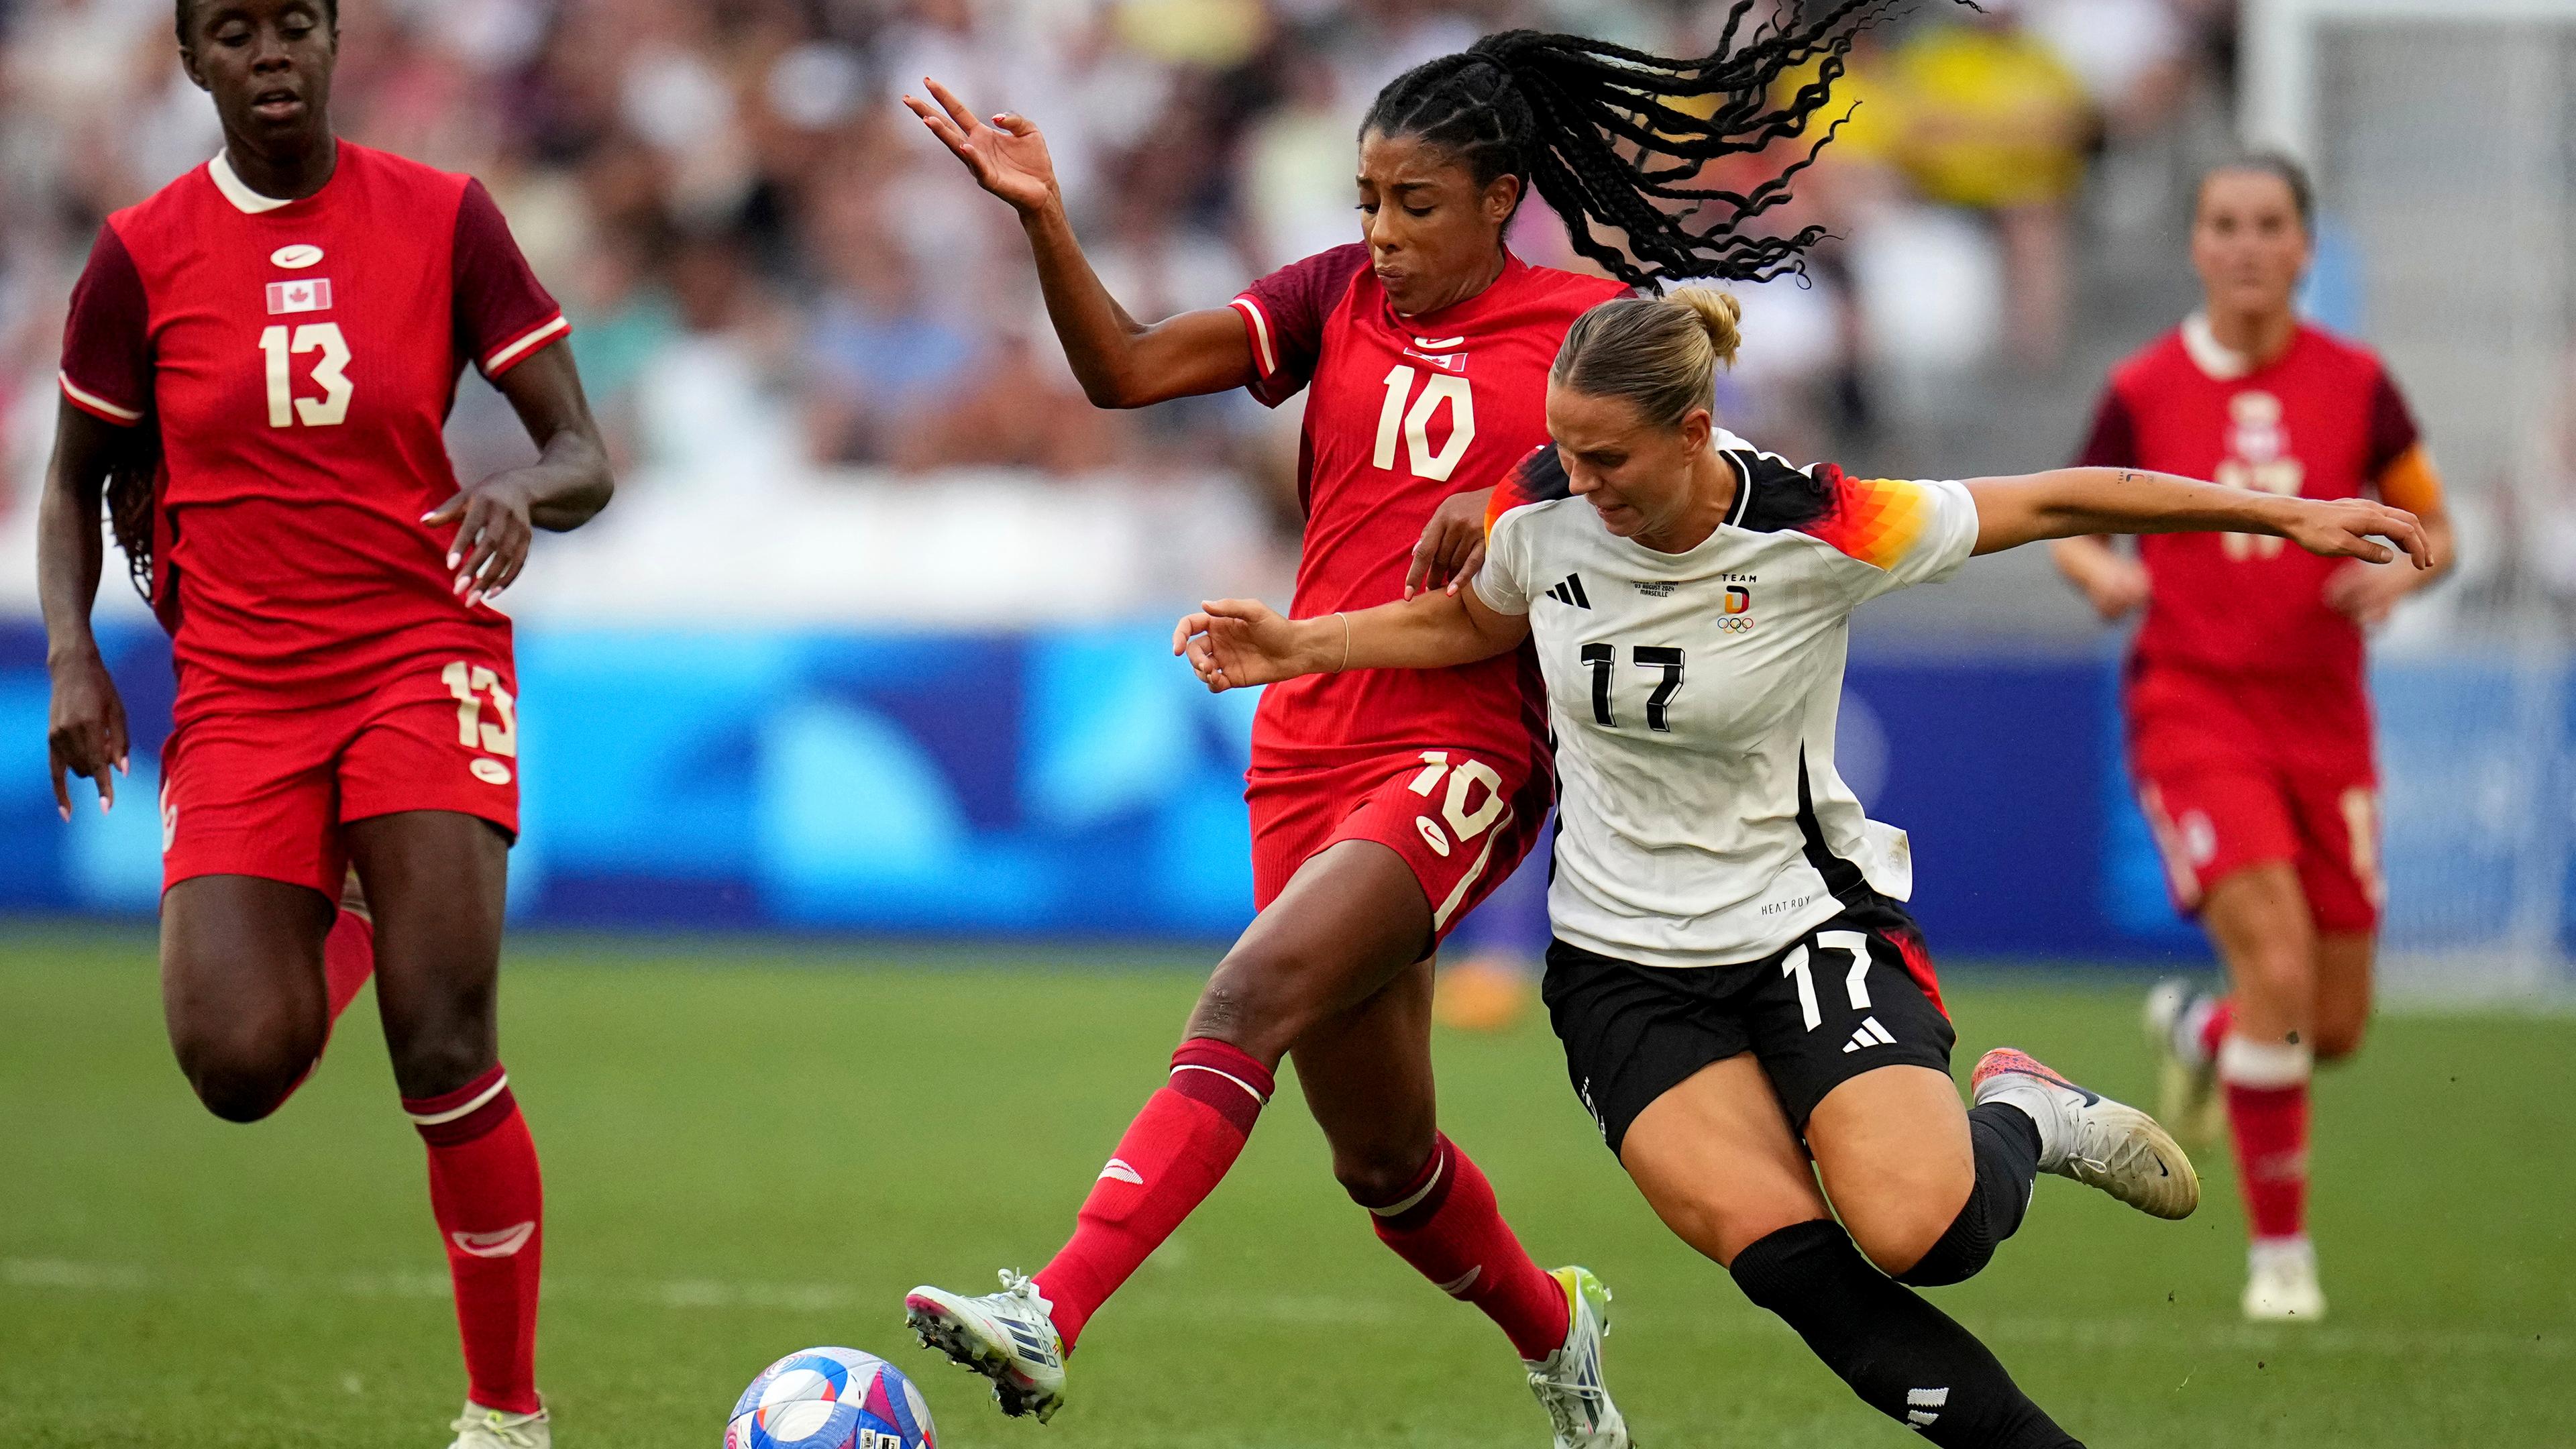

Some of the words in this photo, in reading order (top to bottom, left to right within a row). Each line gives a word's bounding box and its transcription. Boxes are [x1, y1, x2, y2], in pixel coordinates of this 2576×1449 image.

[258, 322, 354, 427] 13
[1373, 364, 1476, 482] 10
[1722, 574, 1757, 583] TEAM
[441, 661, 516, 758] 13
[1581, 643, 1685, 732] 17
[1408, 751, 1504, 843] 10
[1782, 930, 1872, 1032] 17
